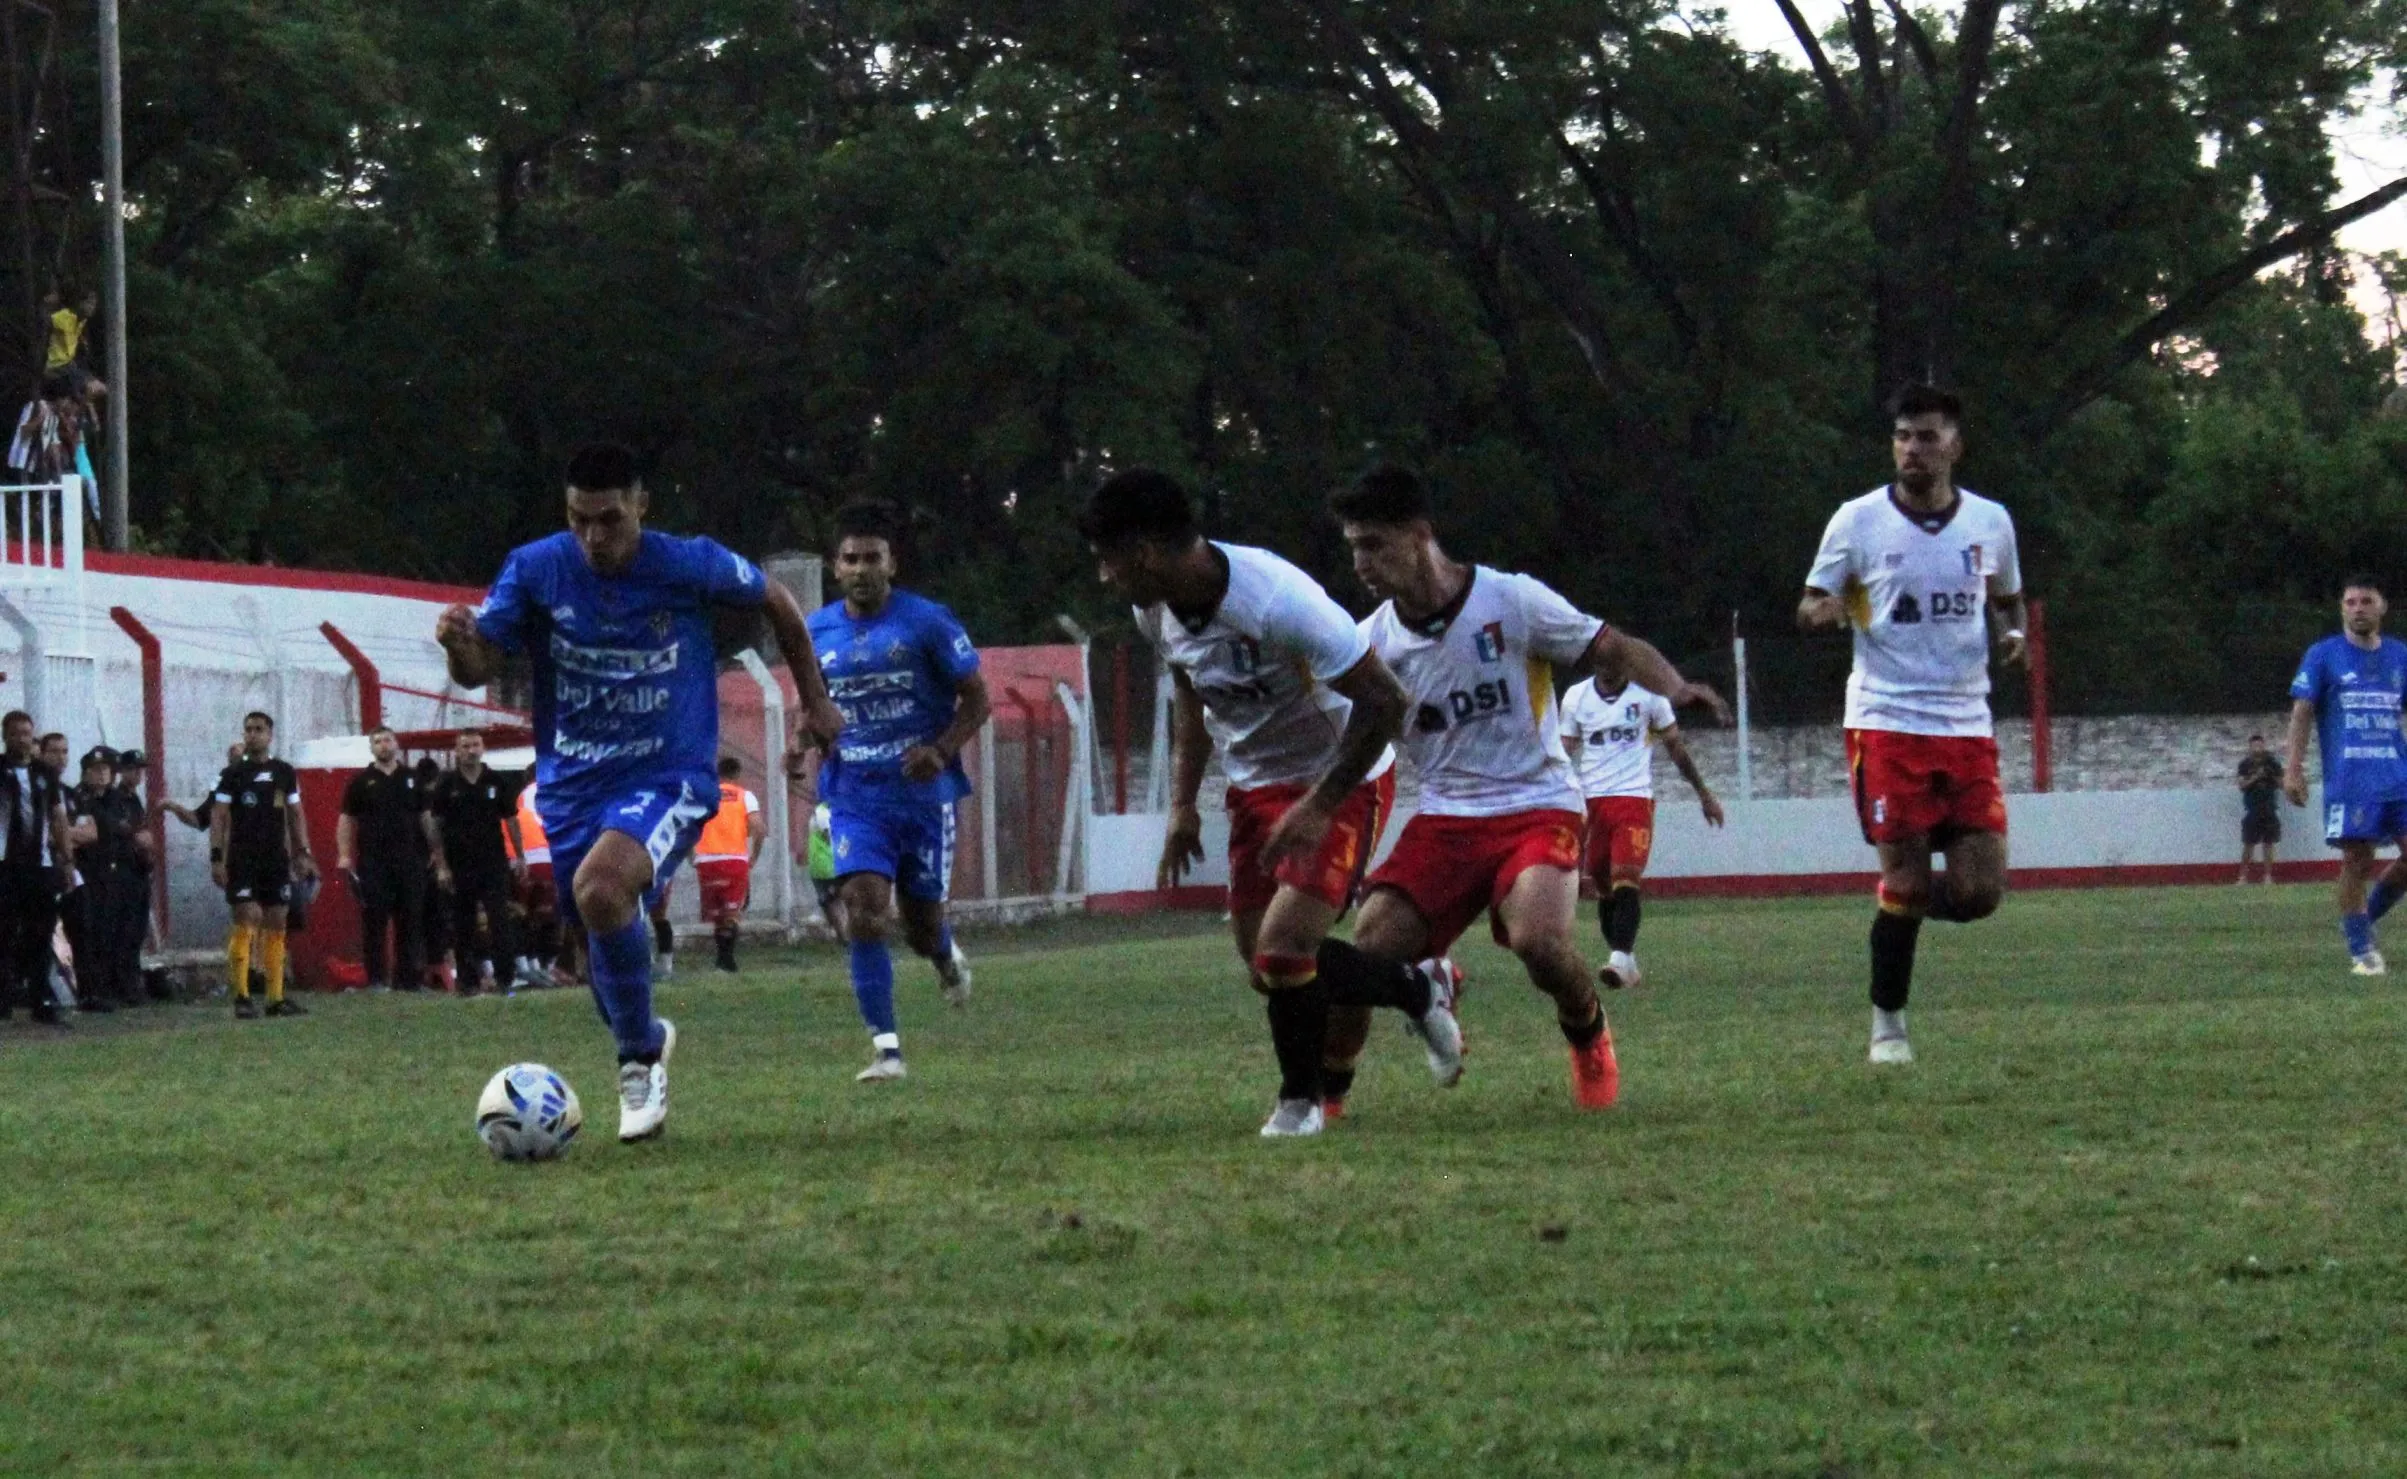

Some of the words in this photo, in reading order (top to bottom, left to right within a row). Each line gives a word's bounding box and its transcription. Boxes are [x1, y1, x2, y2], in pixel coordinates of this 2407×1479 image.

[1931, 592, 1976, 616] DSI
[598, 684, 671, 714] Valle
[837, 702, 859, 725] el
[863, 697, 915, 721] Valle
[1450, 677, 1511, 719] DSI
